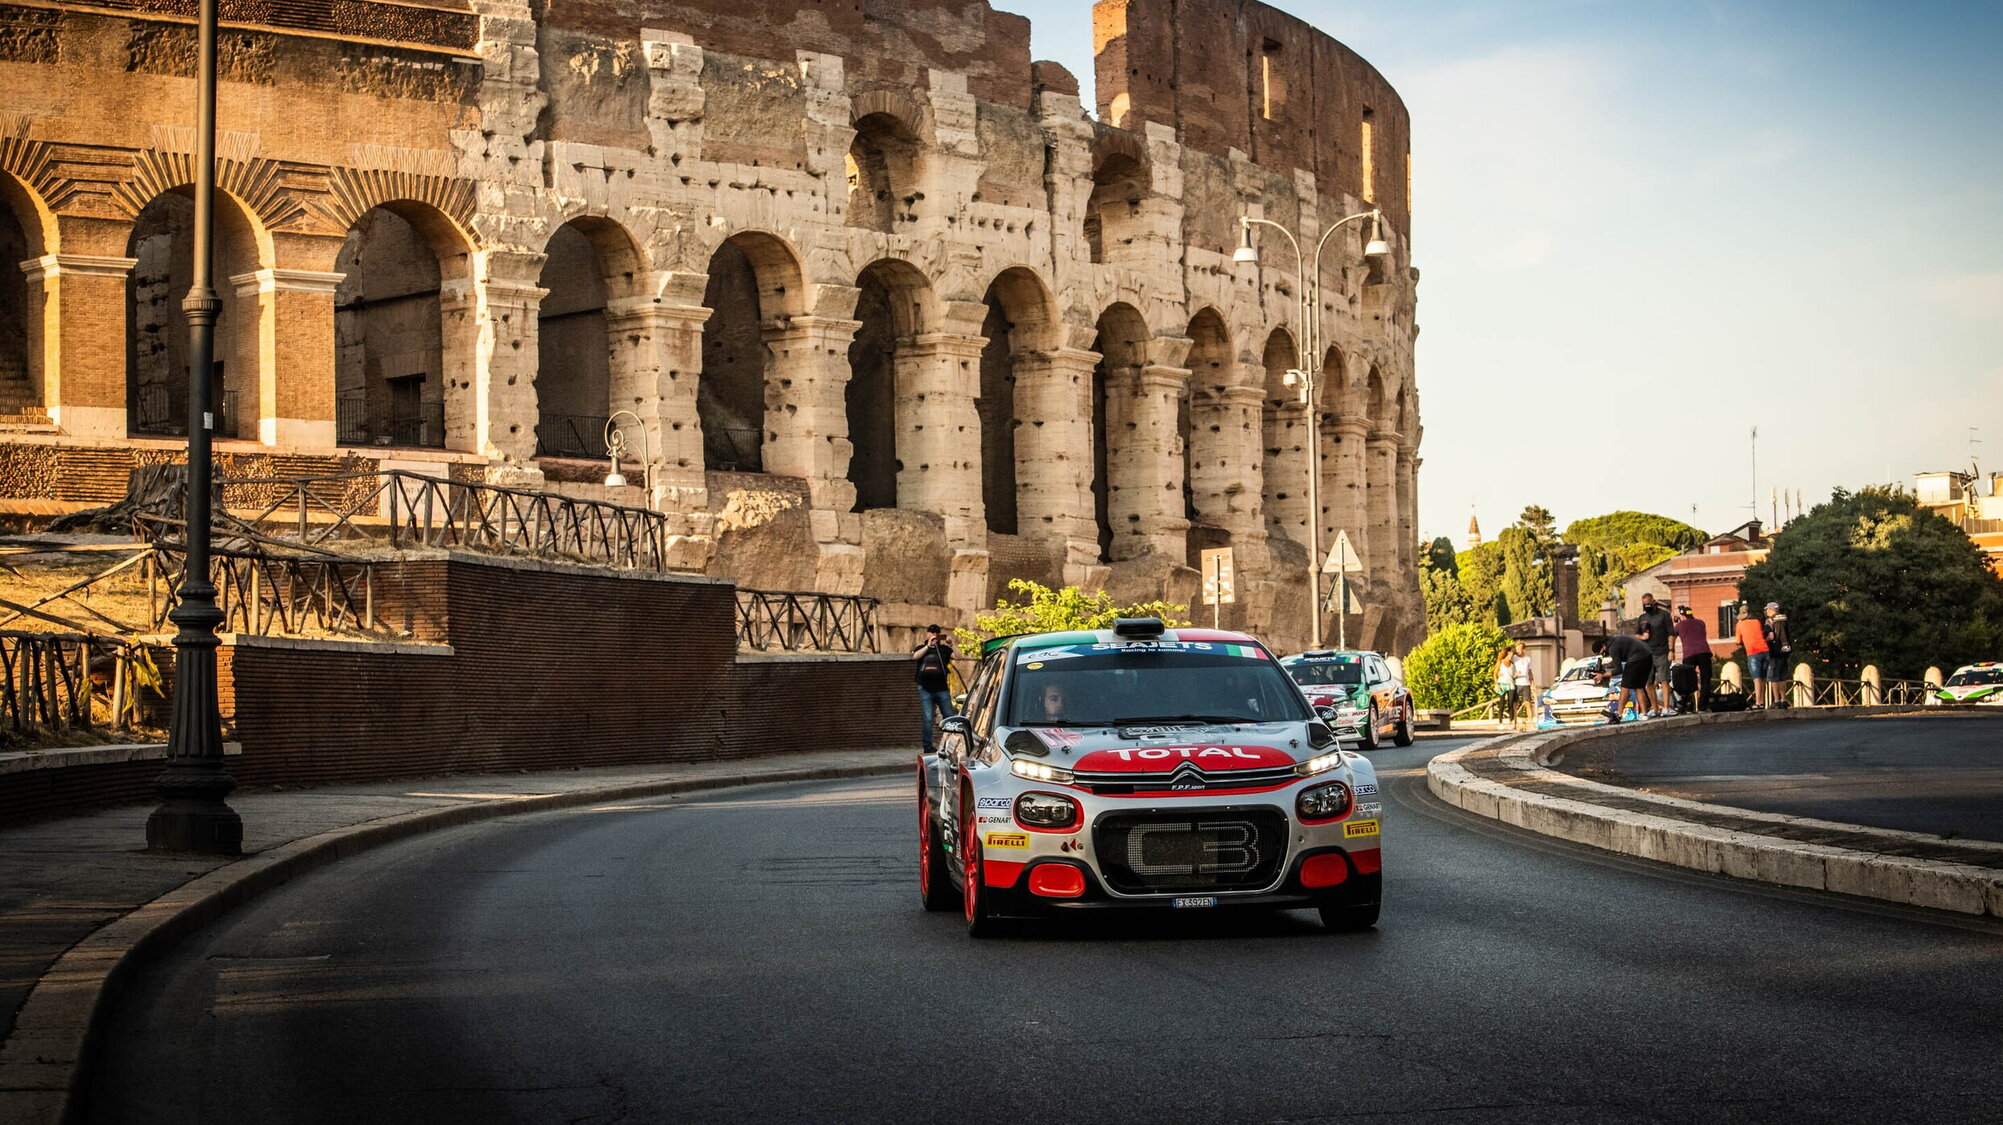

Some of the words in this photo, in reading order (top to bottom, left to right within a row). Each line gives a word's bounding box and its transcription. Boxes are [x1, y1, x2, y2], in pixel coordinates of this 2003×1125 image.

[1092, 642, 1213, 650] SEAJETS
[1107, 747, 1261, 761] TOTAL
[979, 798, 1012, 808] sparco
[988, 816, 1012, 824] GENART
[1346, 822, 1376, 835] PIRELLI
[987, 834, 1026, 847] PIRELLI
[1127, 820, 1260, 875] C3
